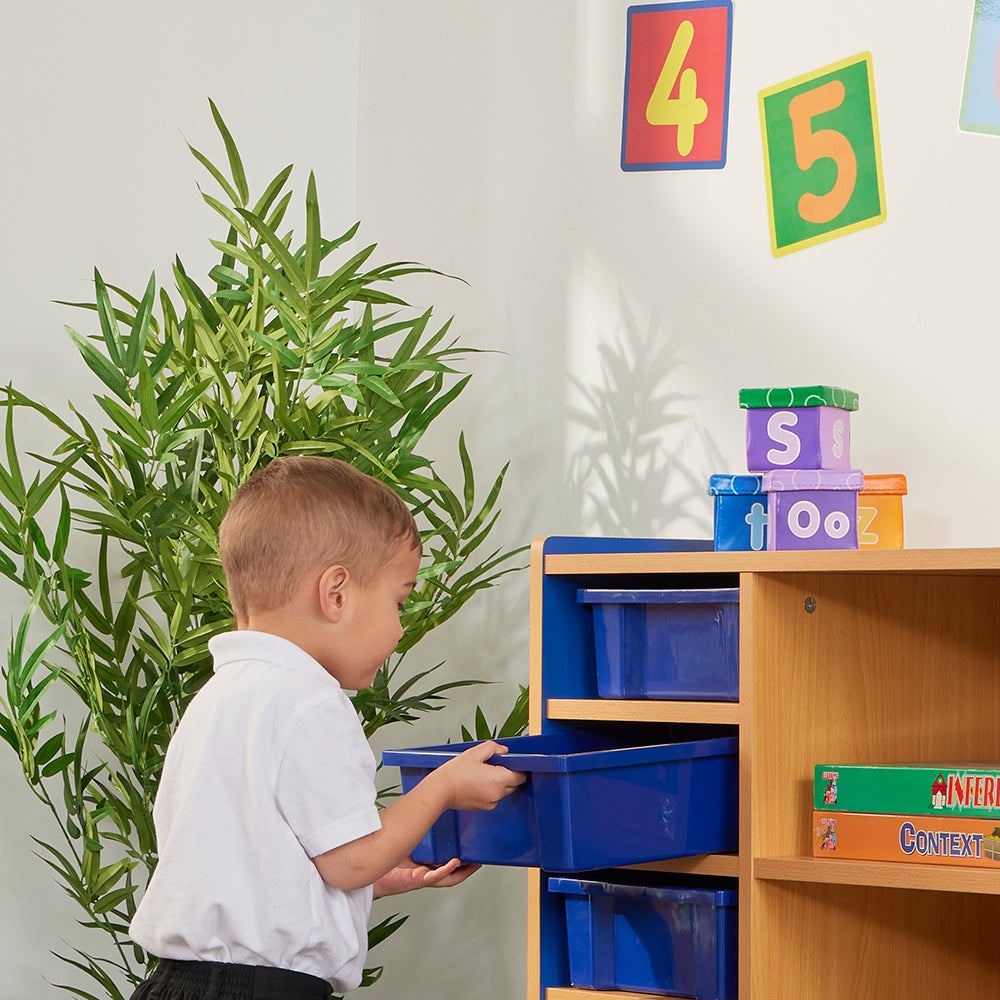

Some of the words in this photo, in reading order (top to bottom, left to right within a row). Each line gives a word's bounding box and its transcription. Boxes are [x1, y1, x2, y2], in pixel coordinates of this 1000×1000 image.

[645, 20, 709, 157] 4
[788, 80, 857, 224] 5
[900, 822, 984, 858] CONTEXT
